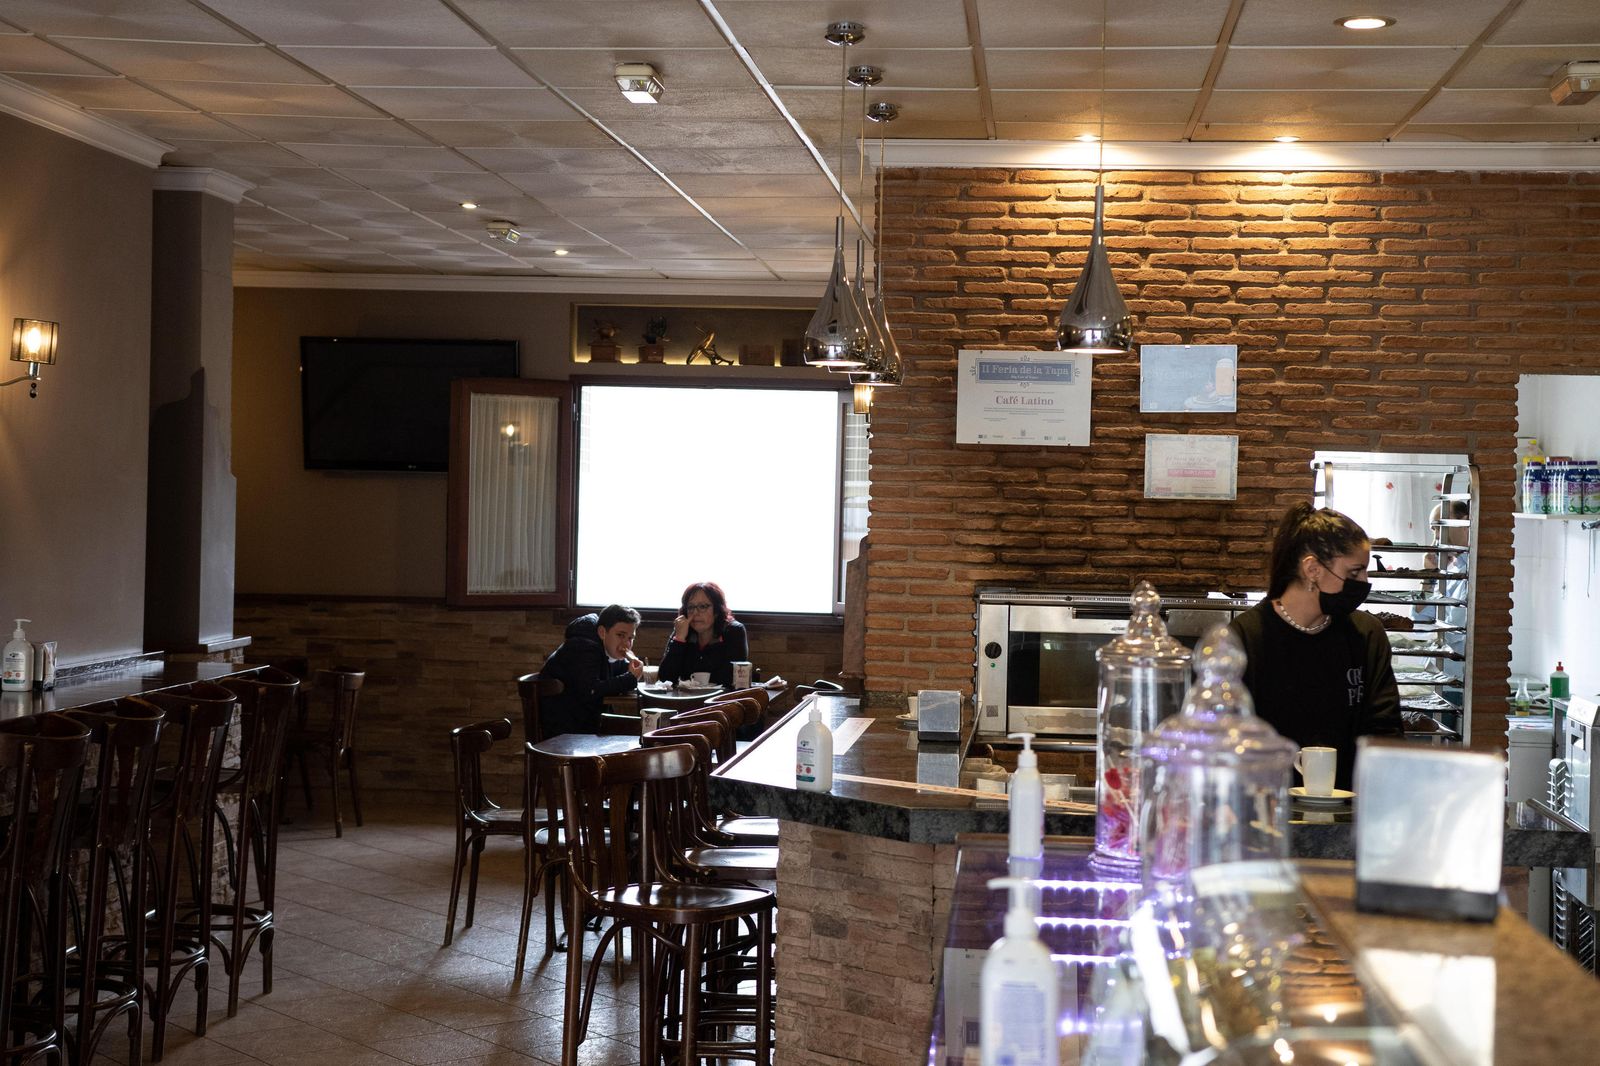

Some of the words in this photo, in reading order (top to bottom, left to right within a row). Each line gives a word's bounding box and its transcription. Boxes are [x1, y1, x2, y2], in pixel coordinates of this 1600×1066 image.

[992, 365, 1018, 374] Feria
[1019, 365, 1032, 374] de
[1033, 366, 1042, 374] la
[1045, 366, 1069, 376] Tapa
[996, 395, 1018, 405] Café
[1021, 396, 1054, 405] Latino
